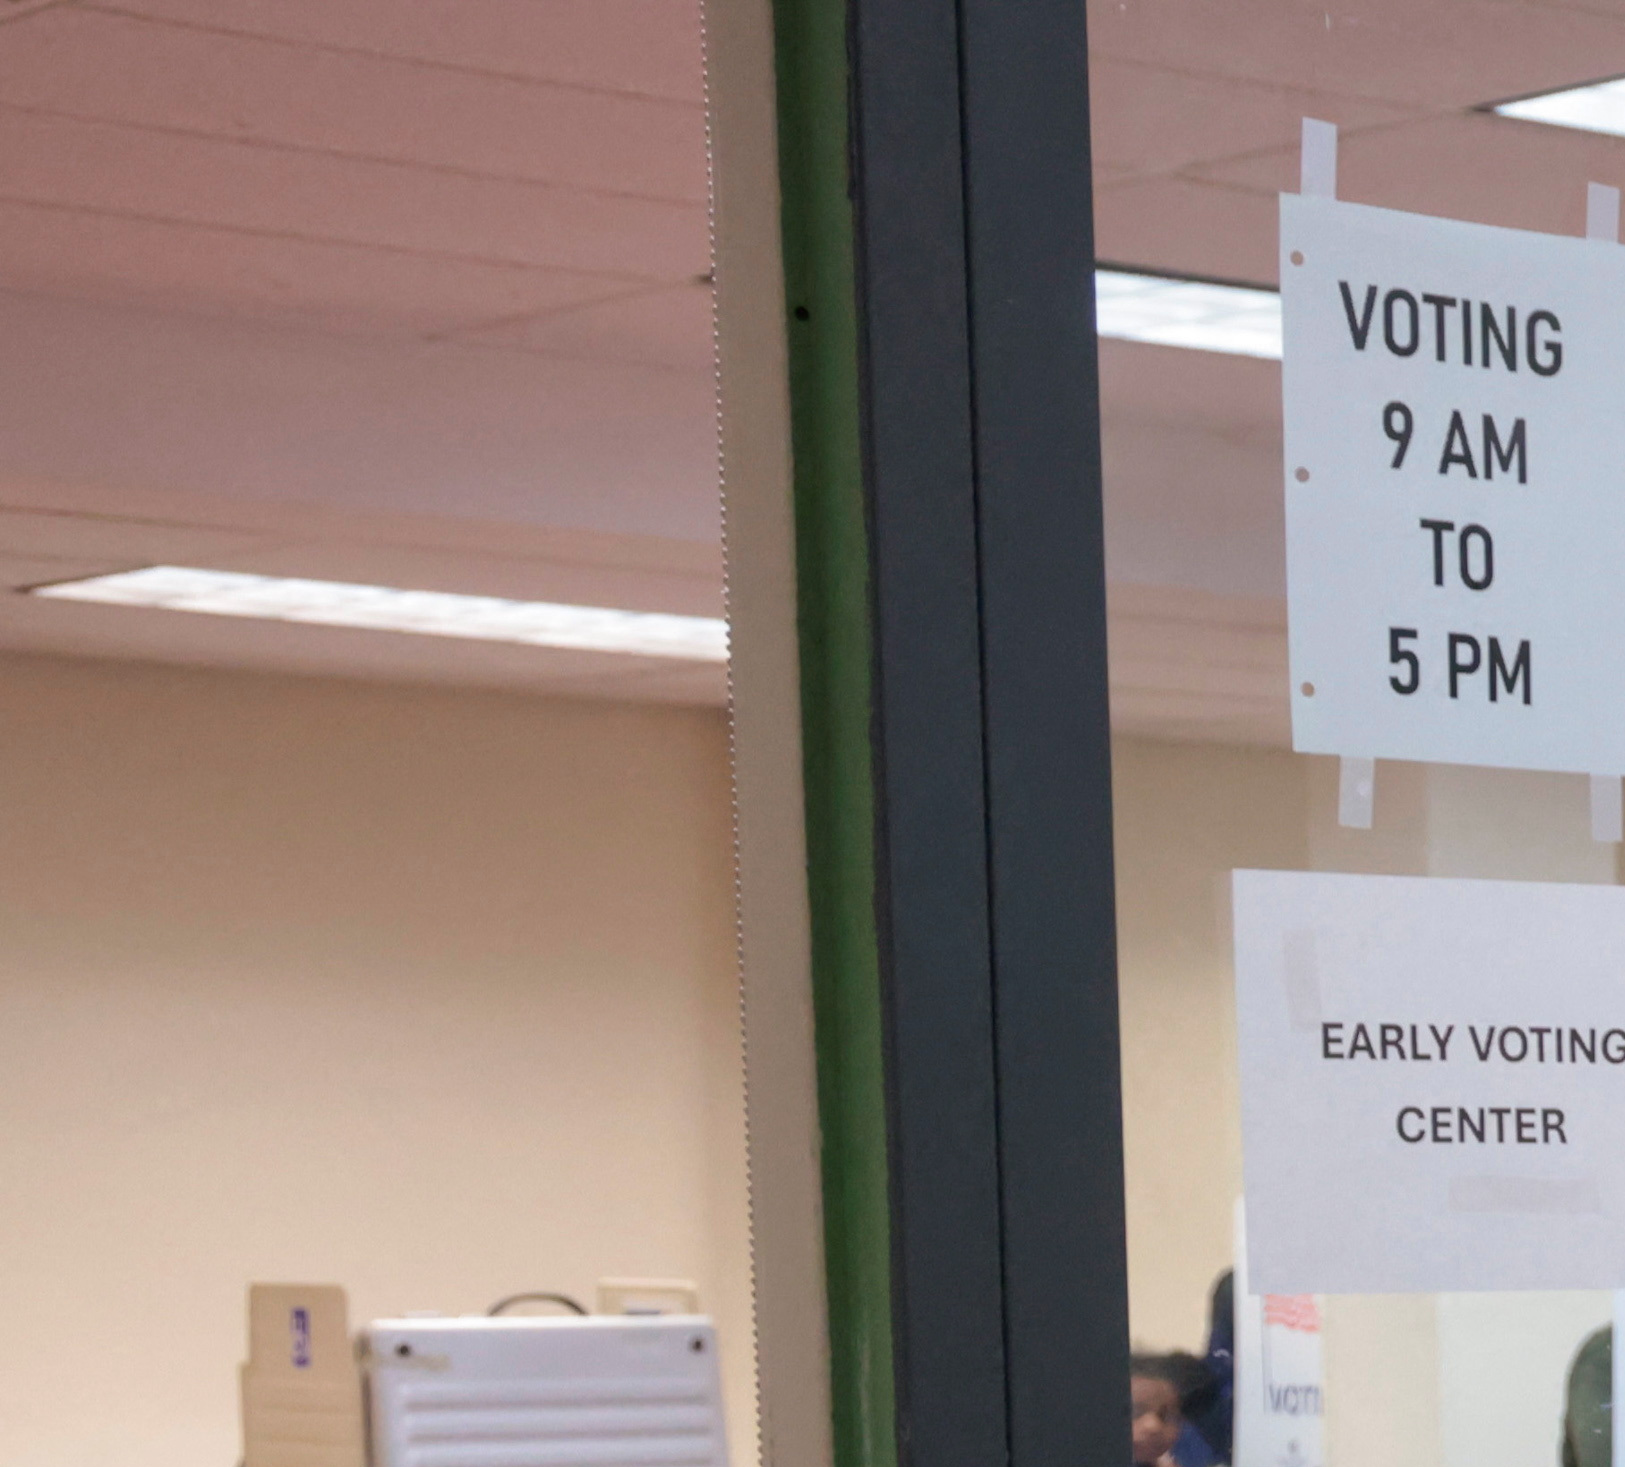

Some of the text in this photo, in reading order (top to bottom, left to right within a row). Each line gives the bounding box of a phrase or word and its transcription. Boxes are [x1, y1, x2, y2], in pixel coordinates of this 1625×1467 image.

[1339, 281, 1563, 377] VOTING
[1382, 401, 1528, 484] 9 AM
[1420, 518, 1494, 591] TO
[1389, 627, 1532, 706] 5 PM
[1321, 1021, 1455, 1064] EARLY
[1396, 1105, 1568, 1145] CENTER
